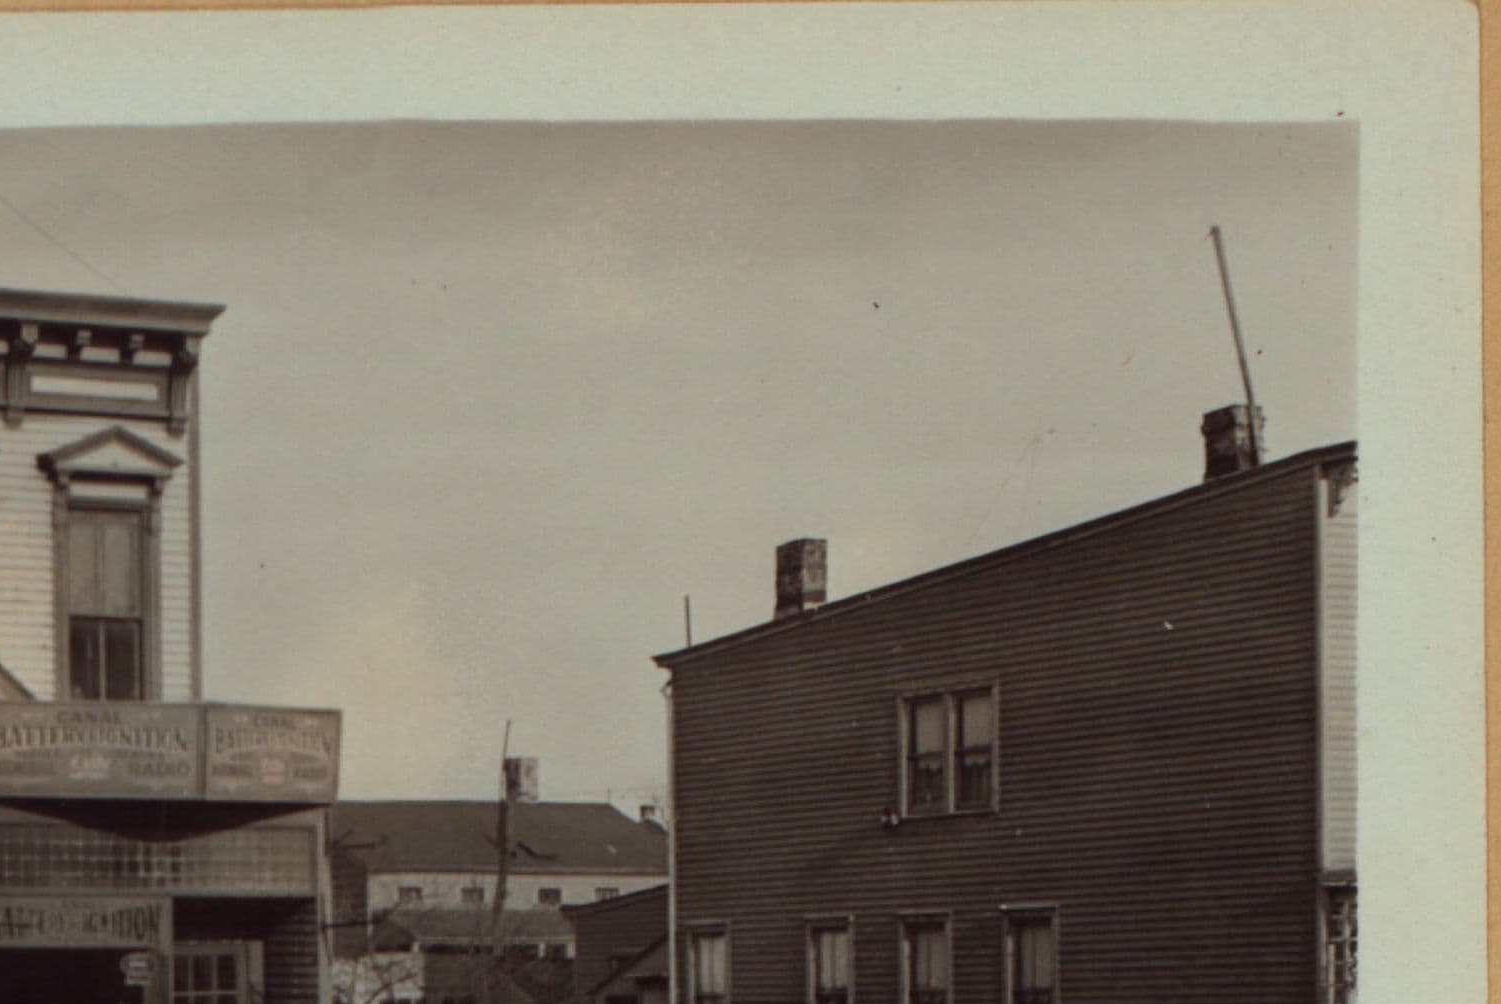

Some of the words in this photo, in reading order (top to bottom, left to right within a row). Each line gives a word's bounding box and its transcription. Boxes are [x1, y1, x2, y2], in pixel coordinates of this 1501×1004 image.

[55, 710, 122, 724] CANAL
[99, 726, 189, 751] IGNITION
[128, 761, 191, 778] RADIO
